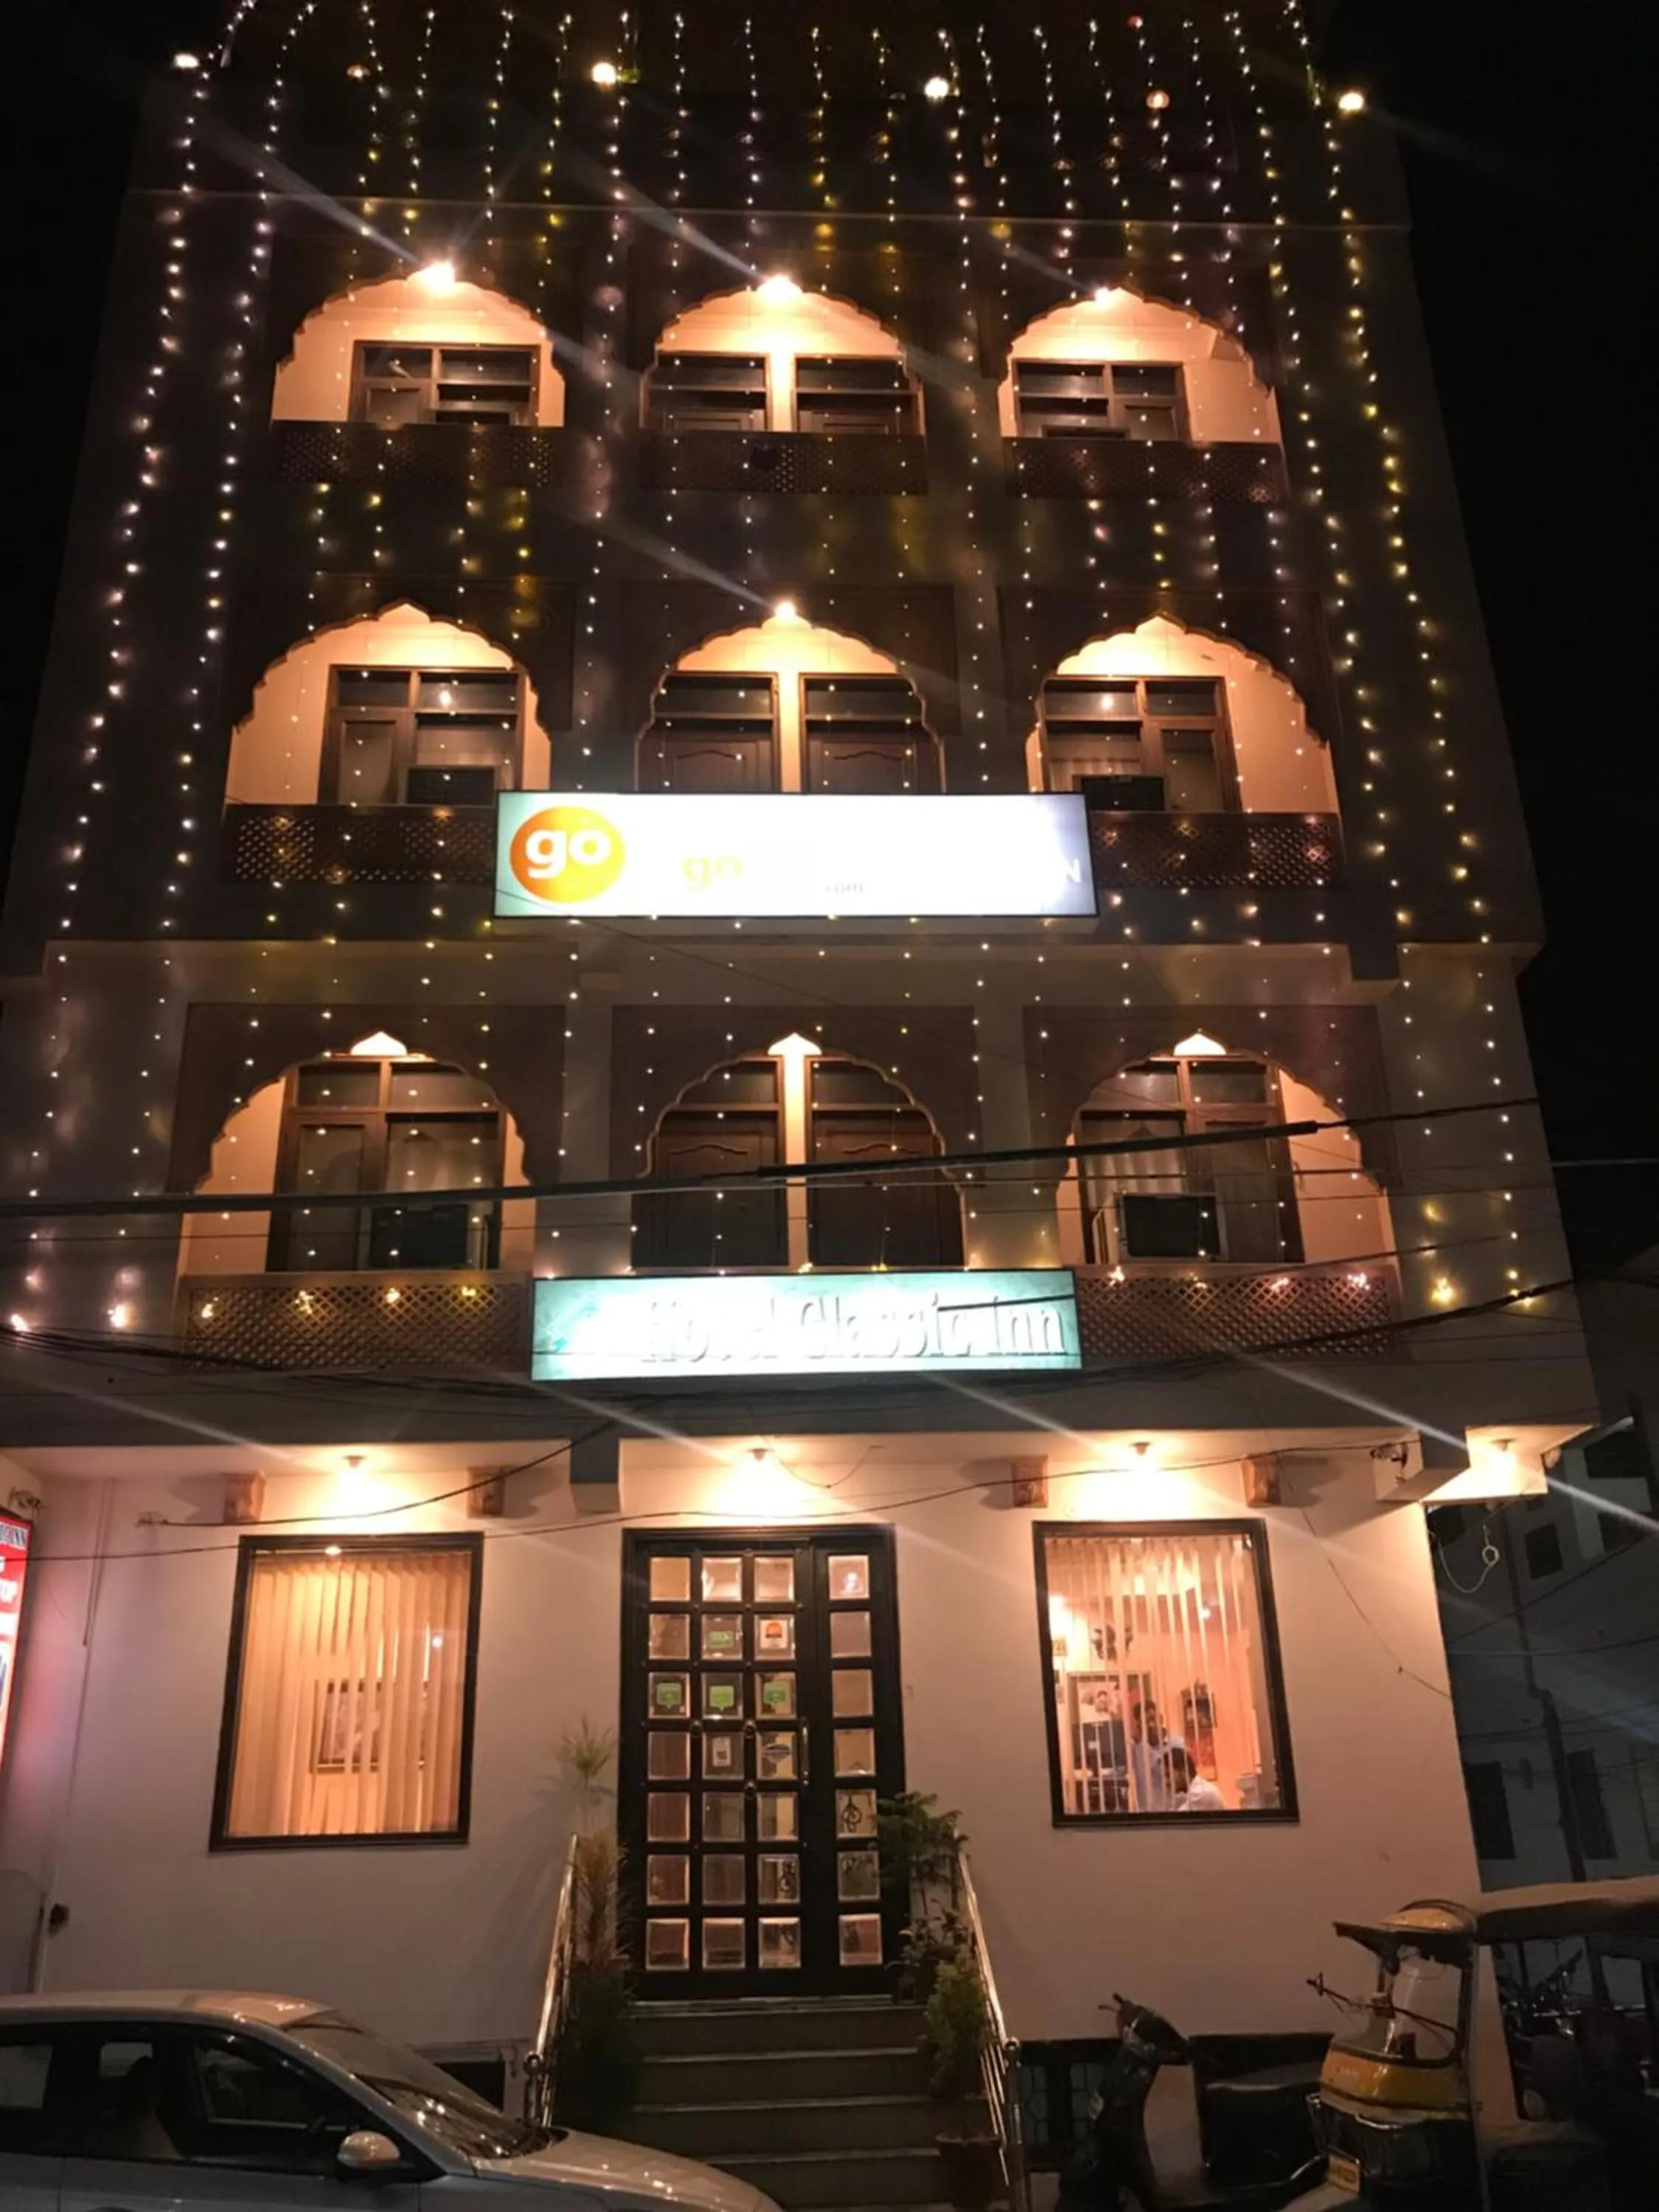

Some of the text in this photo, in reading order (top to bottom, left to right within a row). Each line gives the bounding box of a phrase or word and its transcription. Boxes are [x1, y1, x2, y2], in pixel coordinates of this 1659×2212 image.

[526, 829, 611, 879] go
[682, 854, 743, 892] go
[641, 1293, 1068, 1363] Hol Classic Inn
